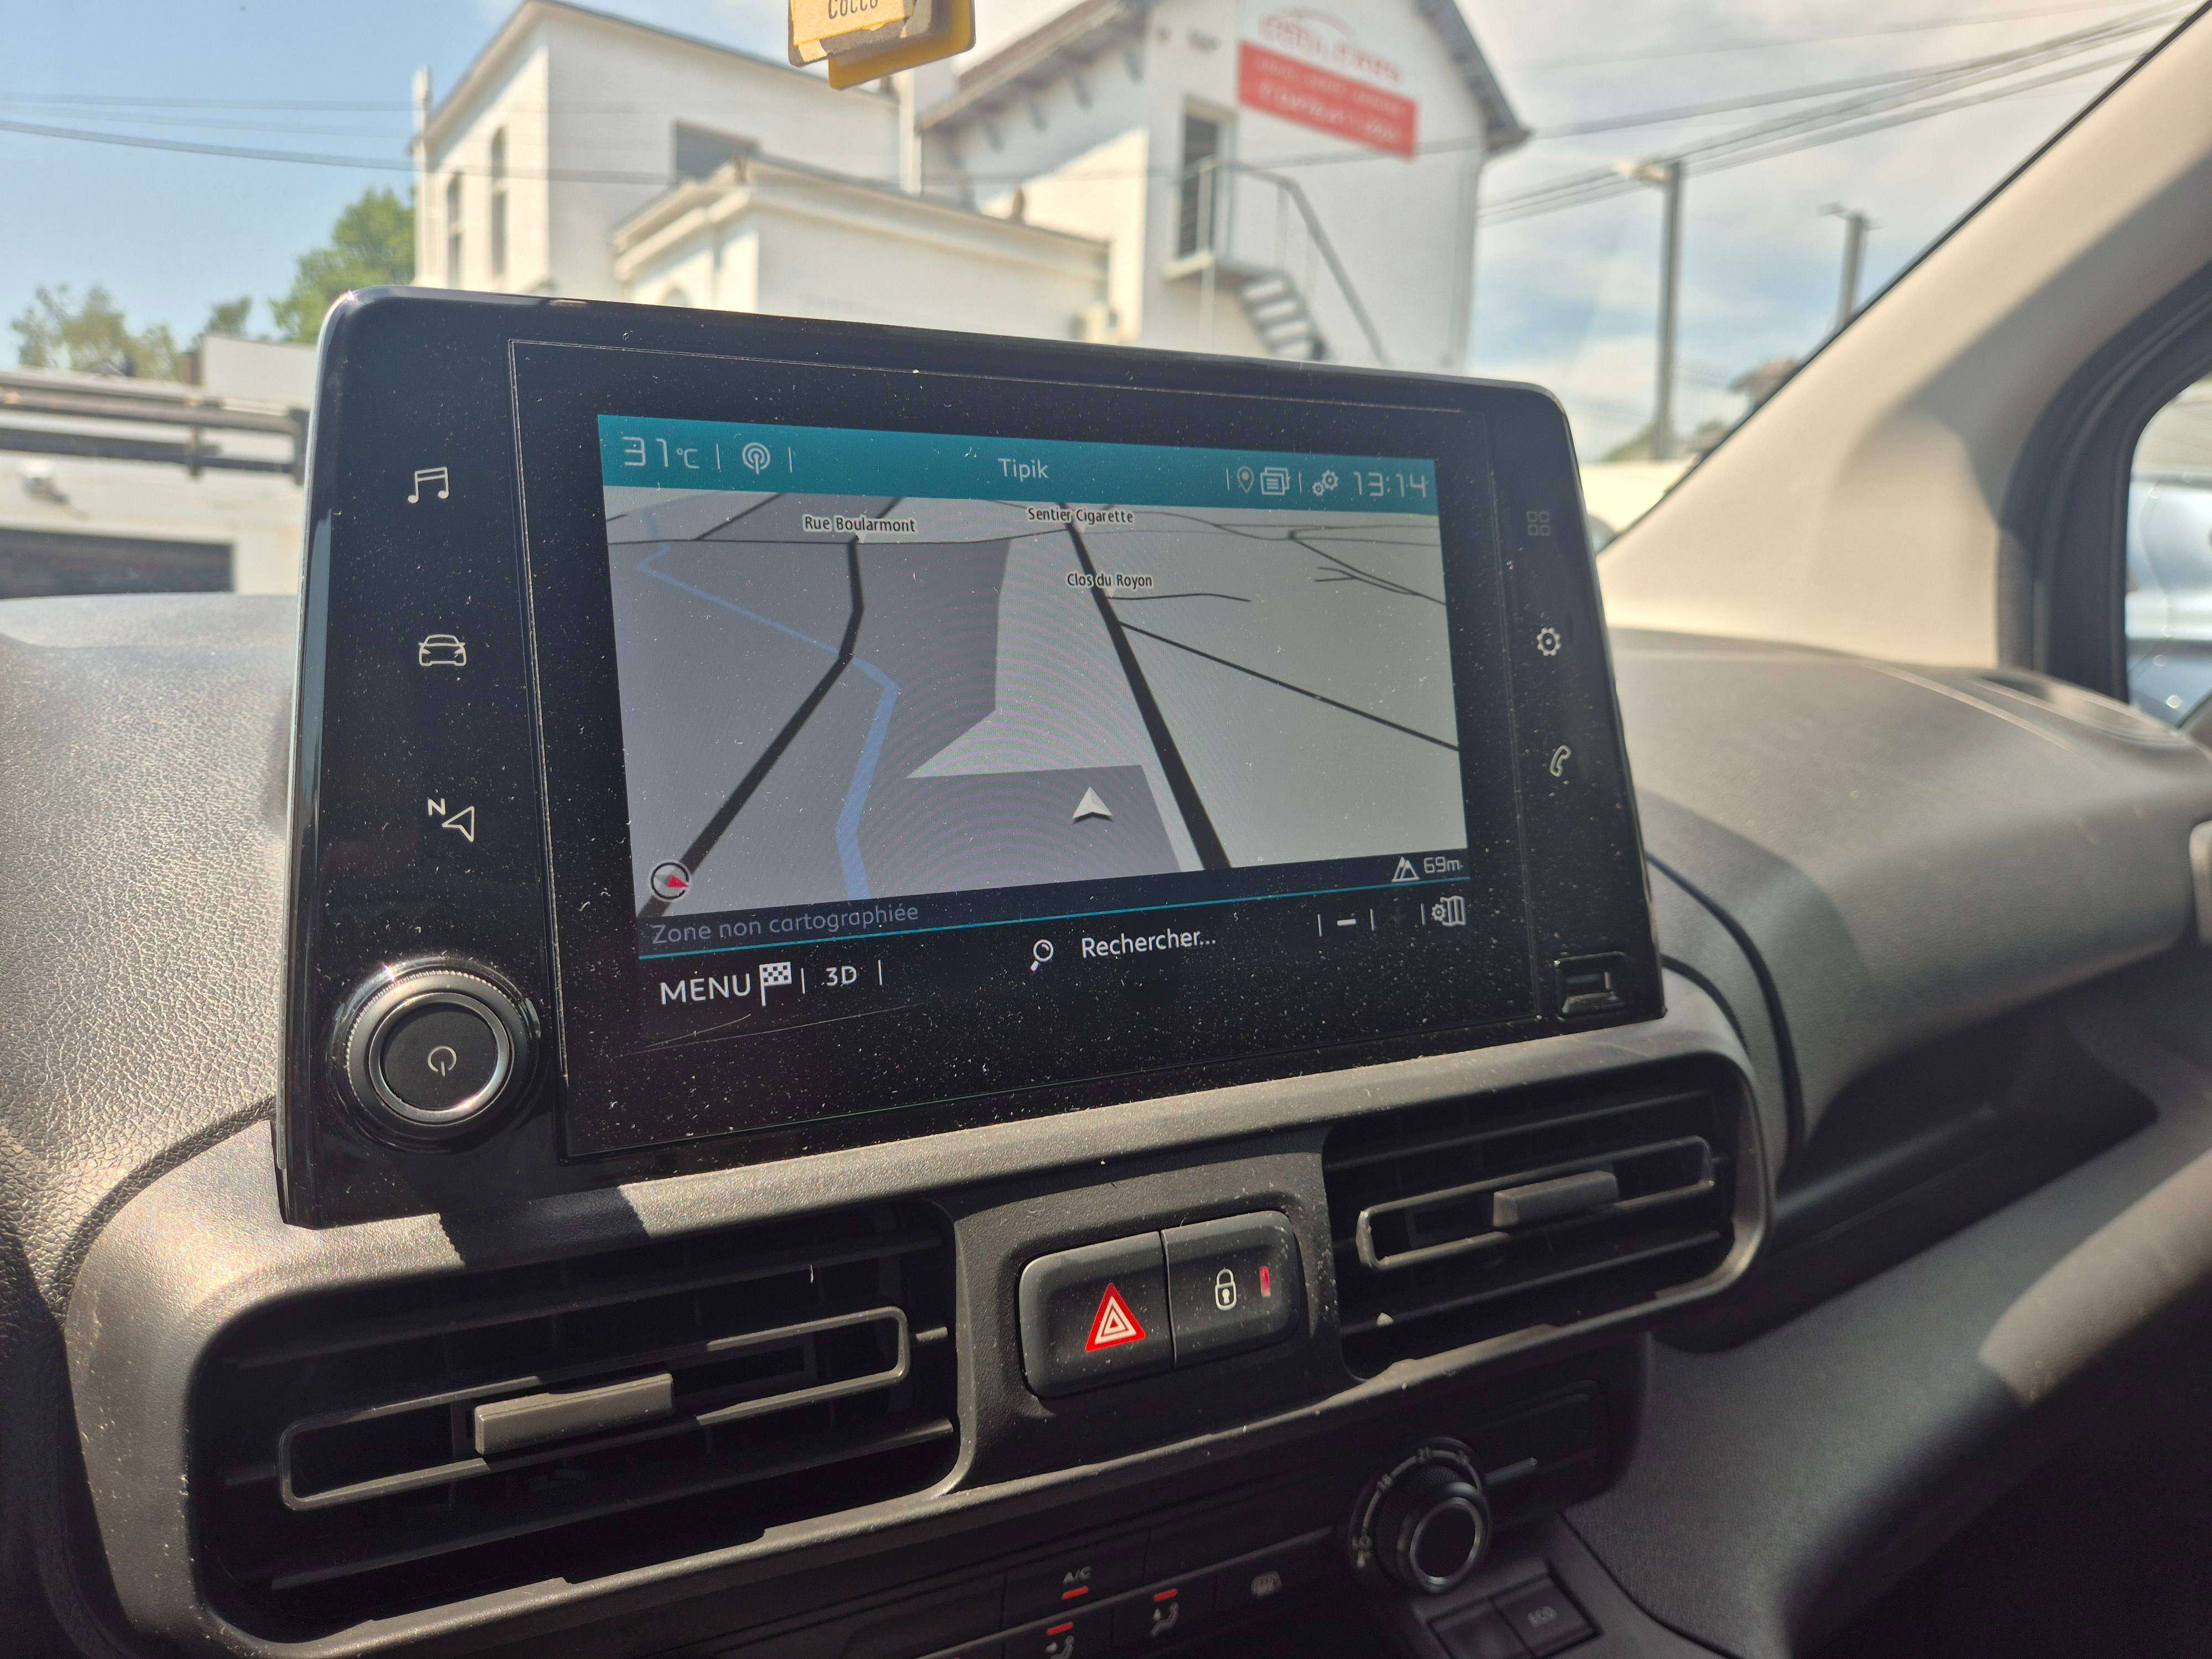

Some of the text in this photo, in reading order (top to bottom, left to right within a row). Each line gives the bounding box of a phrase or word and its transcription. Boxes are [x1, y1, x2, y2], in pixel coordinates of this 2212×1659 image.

[998, 458, 1048, 482] Tipik
[1353, 471, 1426, 498] 13:14
[805, 515, 915, 532] Rue Boularmont
[1029, 508, 1133, 525] Sentier Cigarette
[1067, 572, 1152, 589] Clos du Royon
[427, 798, 446, 816] N
[1424, 856, 1460, 874] 69m
[653, 903, 918, 944] Zone non cartographiée
[1082, 928, 1216, 959] Rechercher...
[825, 966, 857, 987] 3D
[660, 973, 751, 1005] MENU
